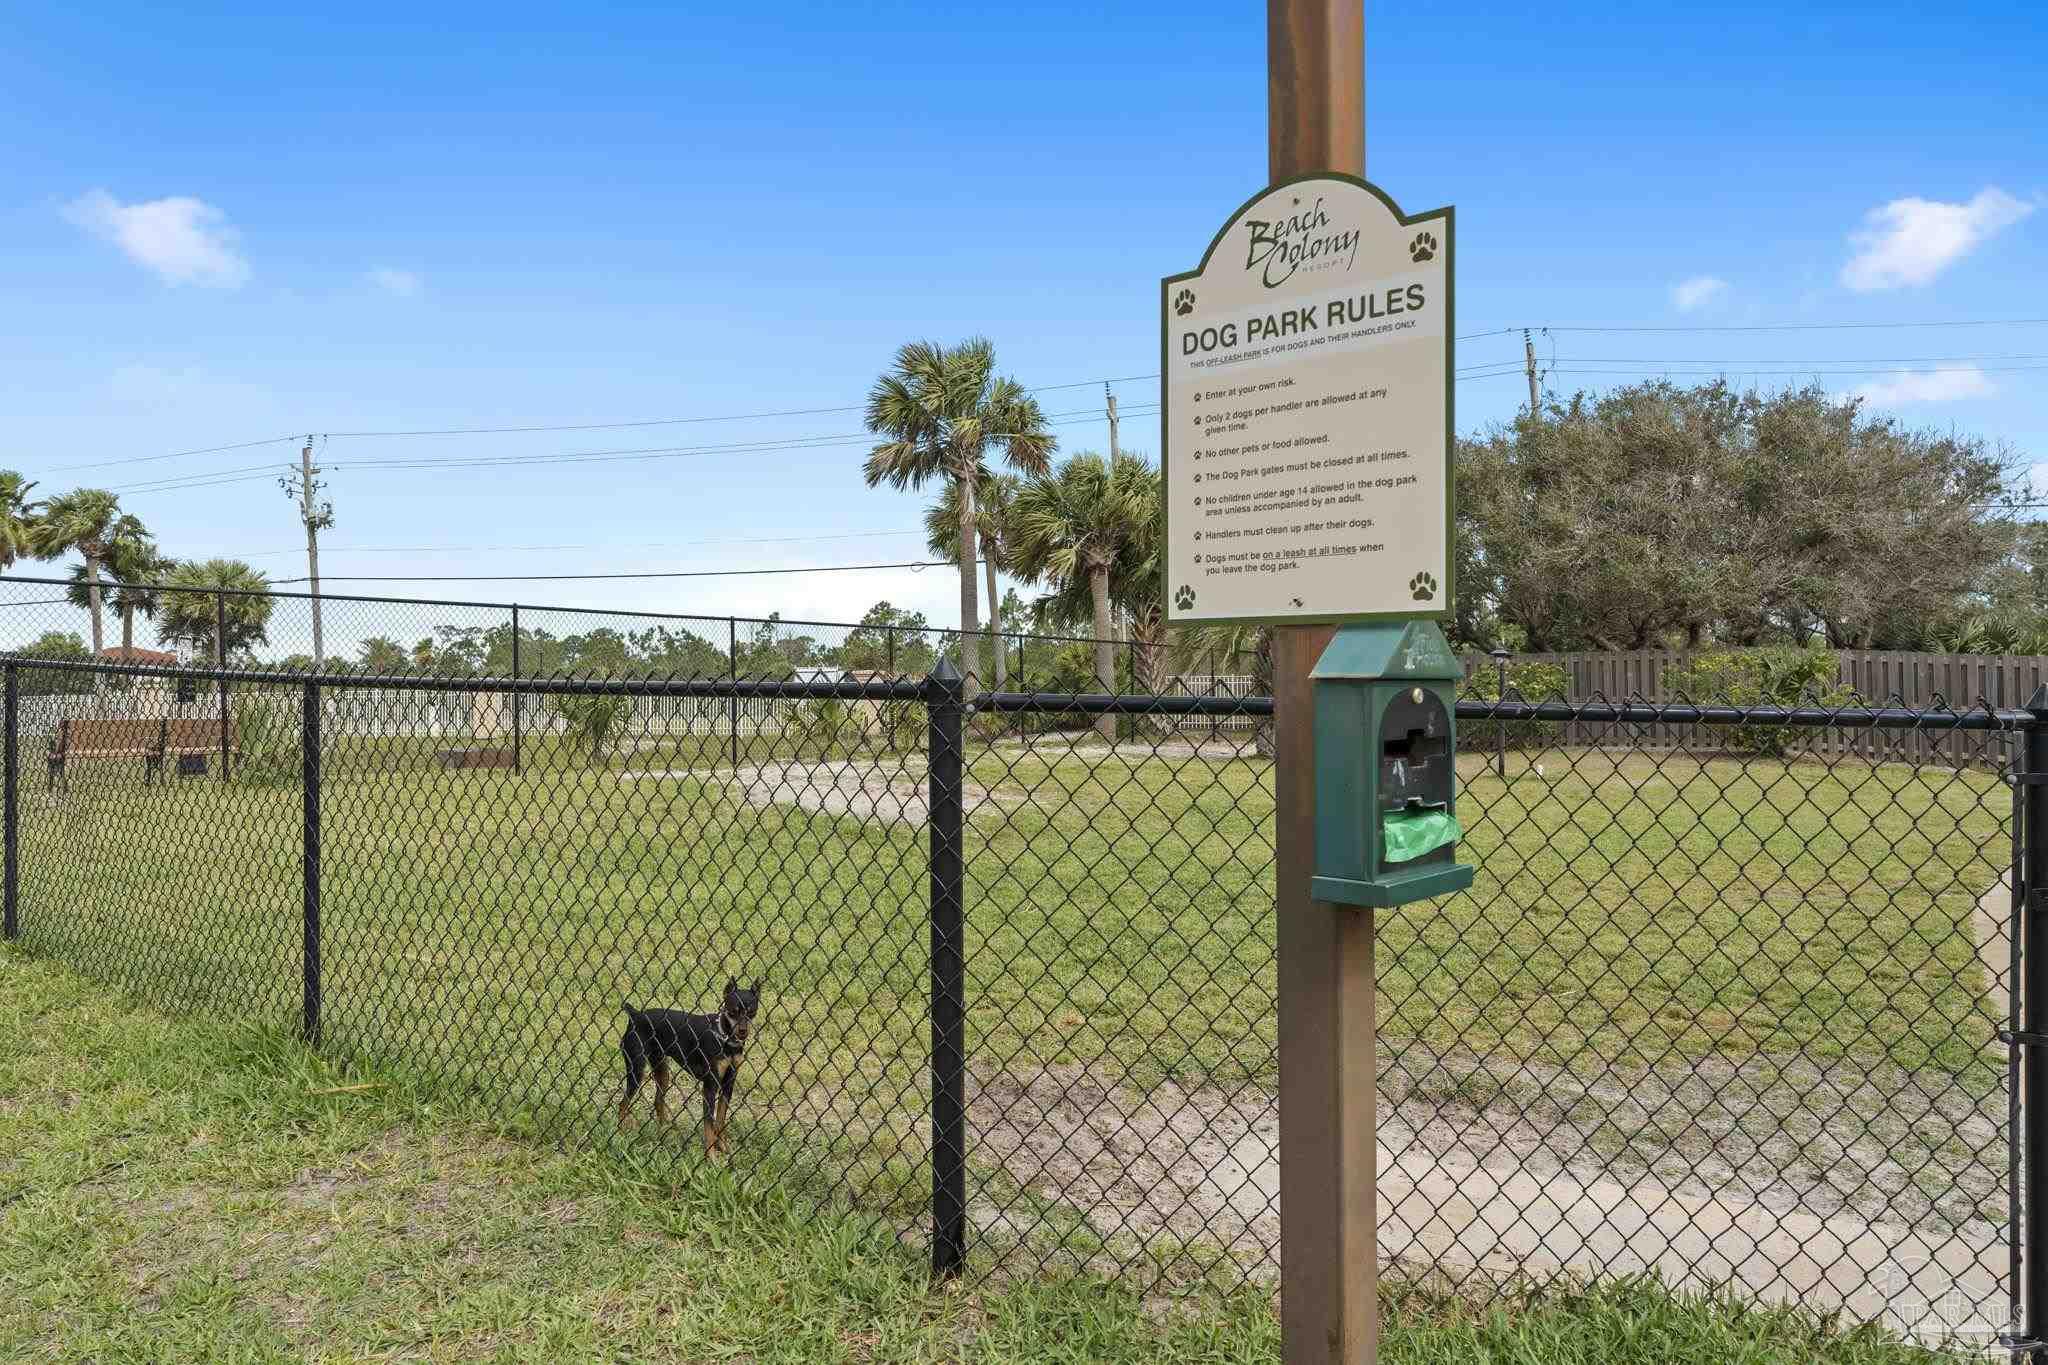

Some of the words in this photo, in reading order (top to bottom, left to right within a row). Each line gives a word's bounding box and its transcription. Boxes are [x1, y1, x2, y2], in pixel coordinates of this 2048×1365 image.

[1245, 197, 1330, 270] Beach
[1263, 230, 1359, 288] Colony
[1183, 323, 1237, 355] DOG
[1247, 306, 1318, 343] PARK
[1327, 283, 1425, 327] RULES
[1243, 350, 1262, 360] PARK
[1271, 344, 1286, 354] FOR
[1287, 340, 1308, 351] DOGS
[1310, 335, 1326, 347] AND
[1327, 332, 1349, 343] THEIR
[1351, 324, 1393, 337] HANDLERS
[1206, 390, 1227, 401] Enter
[1228, 387, 1237, 397] at
[1238, 383, 1257, 396] your
[1258, 381, 1276, 391] own
[1277, 375, 1297, 388] risk.
[1206, 413, 1224, 424] Only
[1225, 411, 1231, 421] 2
[1232, 409, 1253, 420] dogs
[1254, 407, 1269, 417] per
[1271, 401, 1303, 413] handler
[1305, 399, 1319, 408] are
[1321, 392, 1356, 406] allowed
[1358, 391, 1368, 400] at
[1369, 387, 1387, 399] any
[1205, 425, 1227, 437] given
[1228, 422, 1248, 433] time.
[1206, 449, 1217, 458] No
[1218, 446, 1240, 456] other
[1241, 442, 1260, 455] pets
[1261, 442, 1271, 451] or
[1272, 438, 1292, 449] food
[1293, 433, 1330, 447] allowed.
[1206, 472, 1220, 481] The
[1222, 471, 1239, 481] Dog
[1241, 467, 1259, 478] Park
[1260, 464, 1285, 477] gates
[1286, 461, 1308, 473] must
[1310, 460, 1322, 470] be
[1323, 455, 1354, 468] closed
[1356, 455, 1366, 464] at
[1367, 452, 1379, 463] all
[1381, 450, 1411, 461] times.
[1206, 495, 1217, 505] No
[1218, 492, 1251, 504] children
[1253, 489, 1278, 500] under
[1279, 487, 1296, 499] age
[1298, 486, 1308, 495] 14
[1310, 482, 1345, 494] allowed
[1346, 481, 1356, 490] in
[1357, 479, 1373, 489] the
[1374, 478, 1394, 489] dog
[1395, 474, 1417, 487] park
[1206, 507, 1223, 517] area
[1224, 503, 1251, 515] unless
[1252, 498, 1310, 512] accompanied
[1311, 495, 1323, 508] by
[1324, 496, 1337, 505] an
[1338, 492, 1365, 504] adult.
[1206, 529, 1241, 540] Handlers
[1243, 527, 1264, 537] must
[1265, 525, 1288, 535] clean
[1290, 523, 1302, 534] up
[1303, 521, 1325, 533] after
[1326, 518, 1348, 530] their
[1349, 517, 1375, 529] dogs.
[1206, 552, 1226, 564] Dogs
[1228, 550, 1249, 561] must
[1250, 549, 1261, 560] be
[1262, 550, 1274, 560] on
[1275, 550, 1281, 558] a
[1282, 546, 1306, 558] leash
[1307, 546, 1318, 557] at
[1319, 544, 1330, 556] all
[1331, 543, 1358, 555] times
[1359, 541, 1384, 553] when
[1205, 566, 1221, 577] you
[1222, 562, 1243, 574] leave
[1244, 561, 1258, 572] the
[1259, 560, 1277, 572] dog
[1278, 559, 1301, 571] park.
